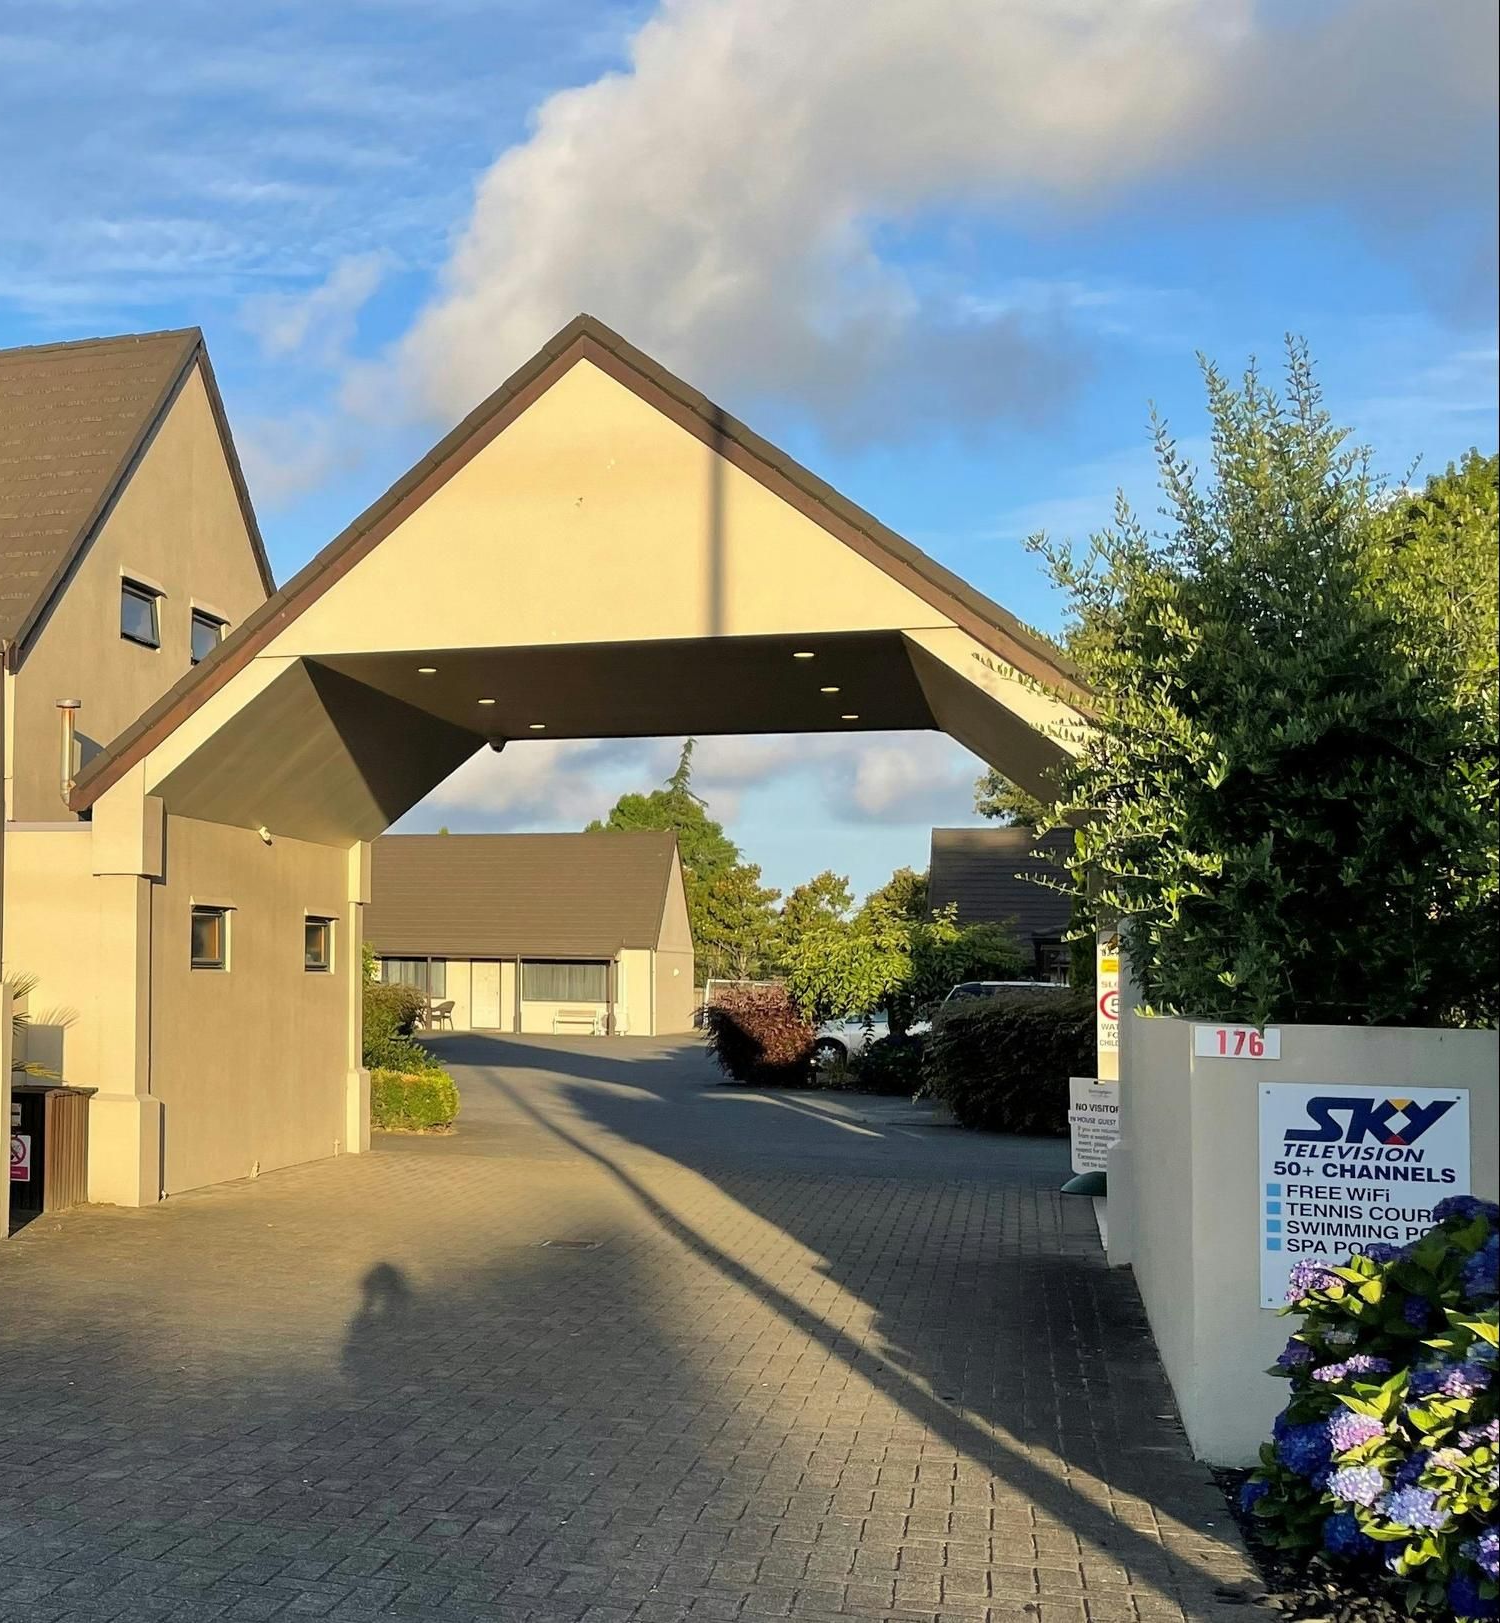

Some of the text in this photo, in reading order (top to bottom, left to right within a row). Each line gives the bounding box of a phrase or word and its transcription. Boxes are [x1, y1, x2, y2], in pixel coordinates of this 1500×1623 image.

[1216, 1030, 1264, 1057] 176
[1075, 1102, 1088, 1112] NO
[1284, 1096, 1458, 1146] SKY
[1284, 1143, 1425, 1163] TELEVISION
[1273, 1161, 1456, 1183] 50+ CHANNELS
[1287, 1184, 1390, 1203] FREE WiFi
[1286, 1202, 1432, 1223] TENNIS COUR
[1287, 1220, 1399, 1240] SWIMMING
[1287, 1238, 1328, 1254] SPA
